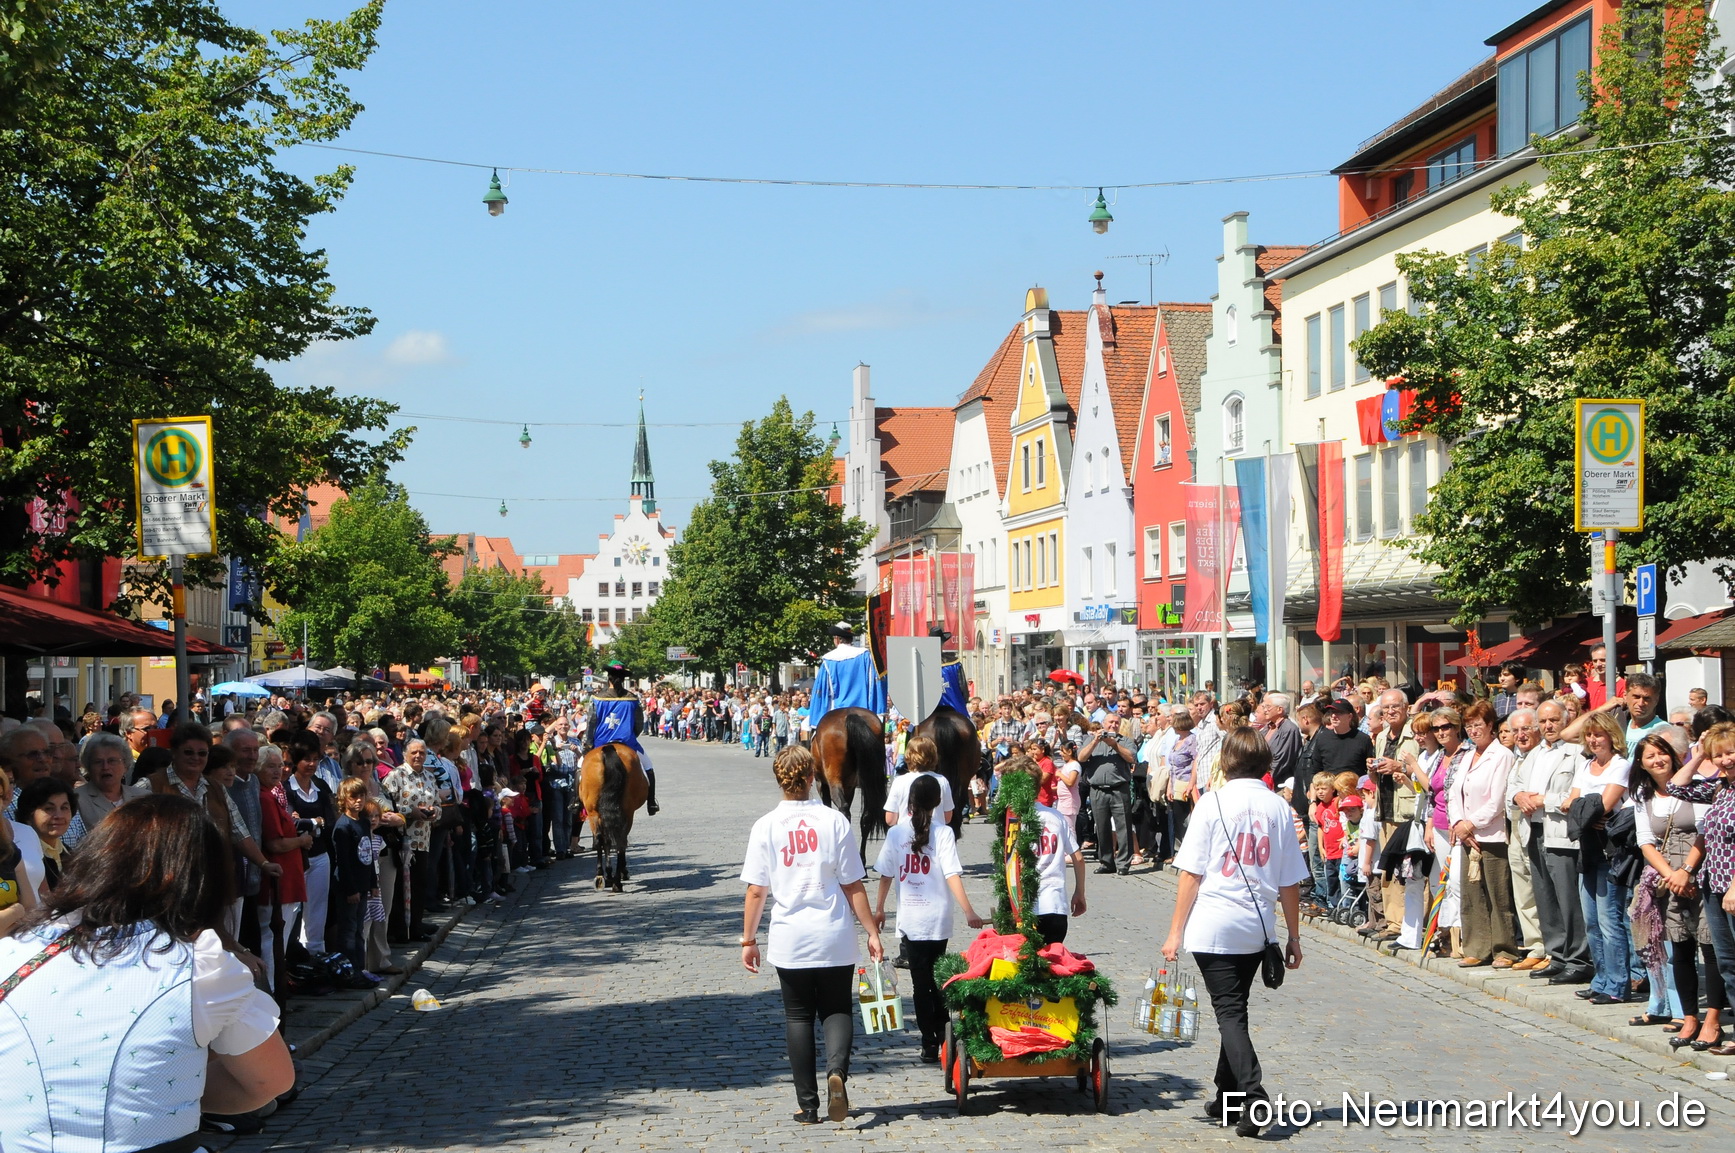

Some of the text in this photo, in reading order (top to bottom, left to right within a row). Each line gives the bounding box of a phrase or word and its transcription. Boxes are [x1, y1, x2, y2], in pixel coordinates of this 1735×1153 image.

[1584, 470, 1635, 478] Oberer Markt
[145, 492, 205, 503] Oberer Markt
[1641, 571, 1652, 610] P
